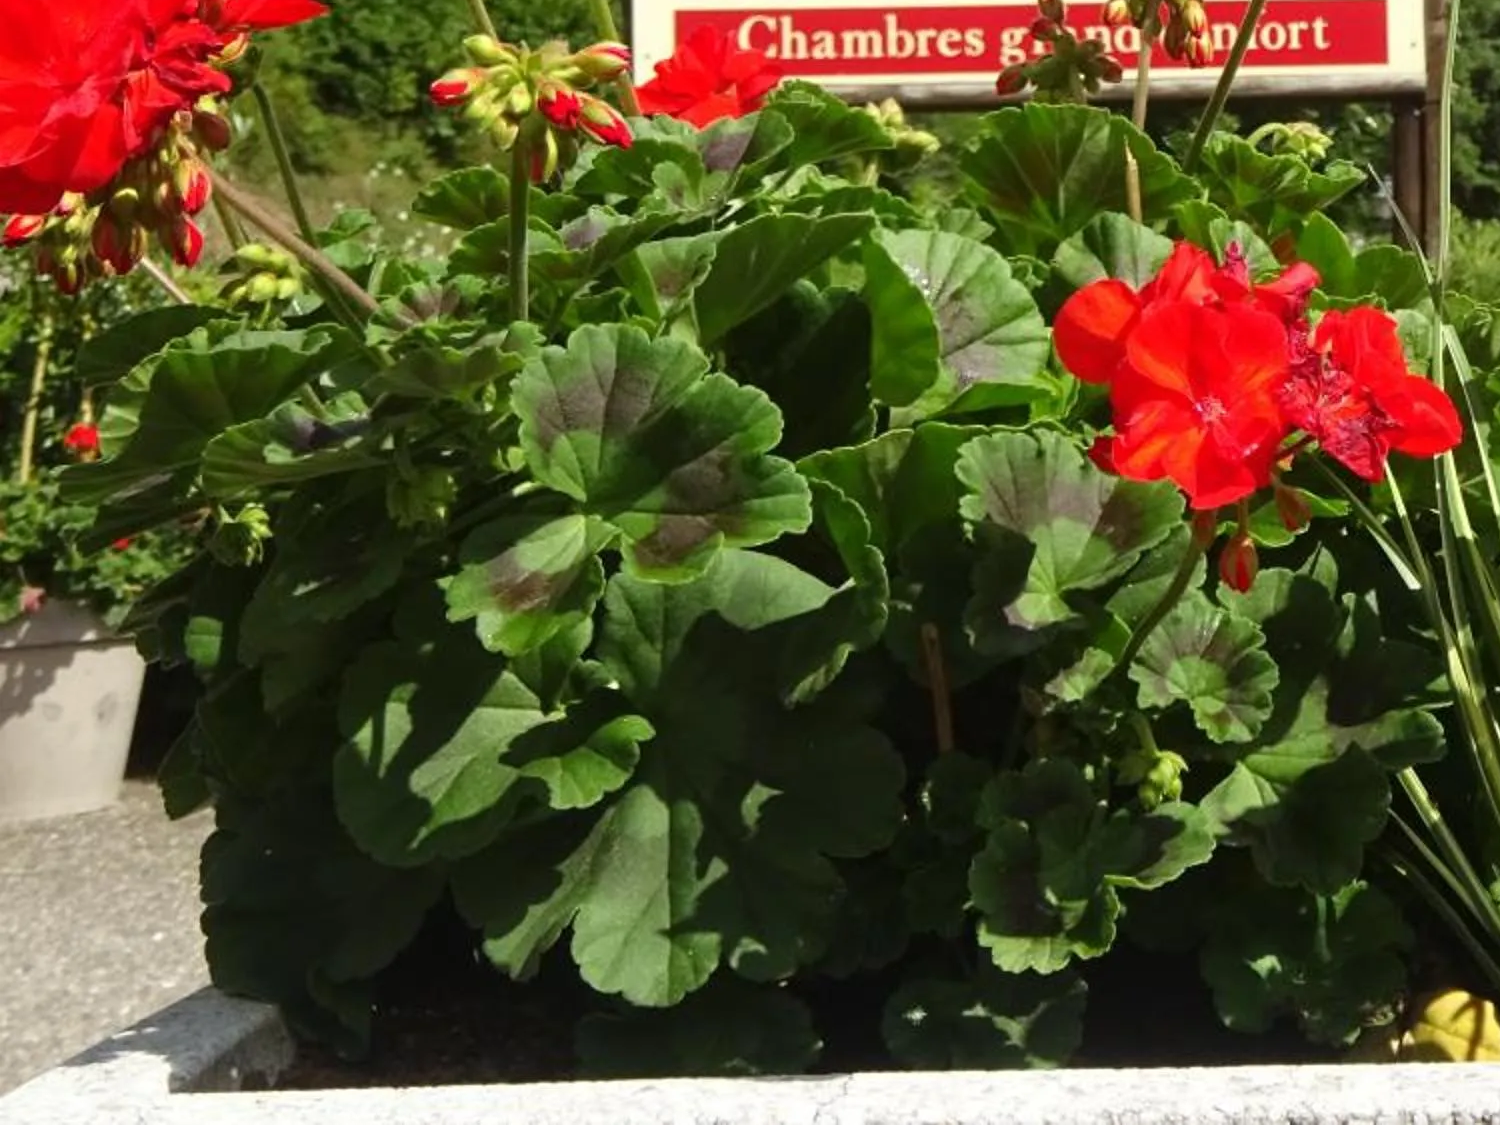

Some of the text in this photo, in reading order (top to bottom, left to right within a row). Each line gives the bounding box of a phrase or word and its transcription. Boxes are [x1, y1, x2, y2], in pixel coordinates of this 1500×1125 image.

[737, 13, 1331, 67] Chambres gnd nort
